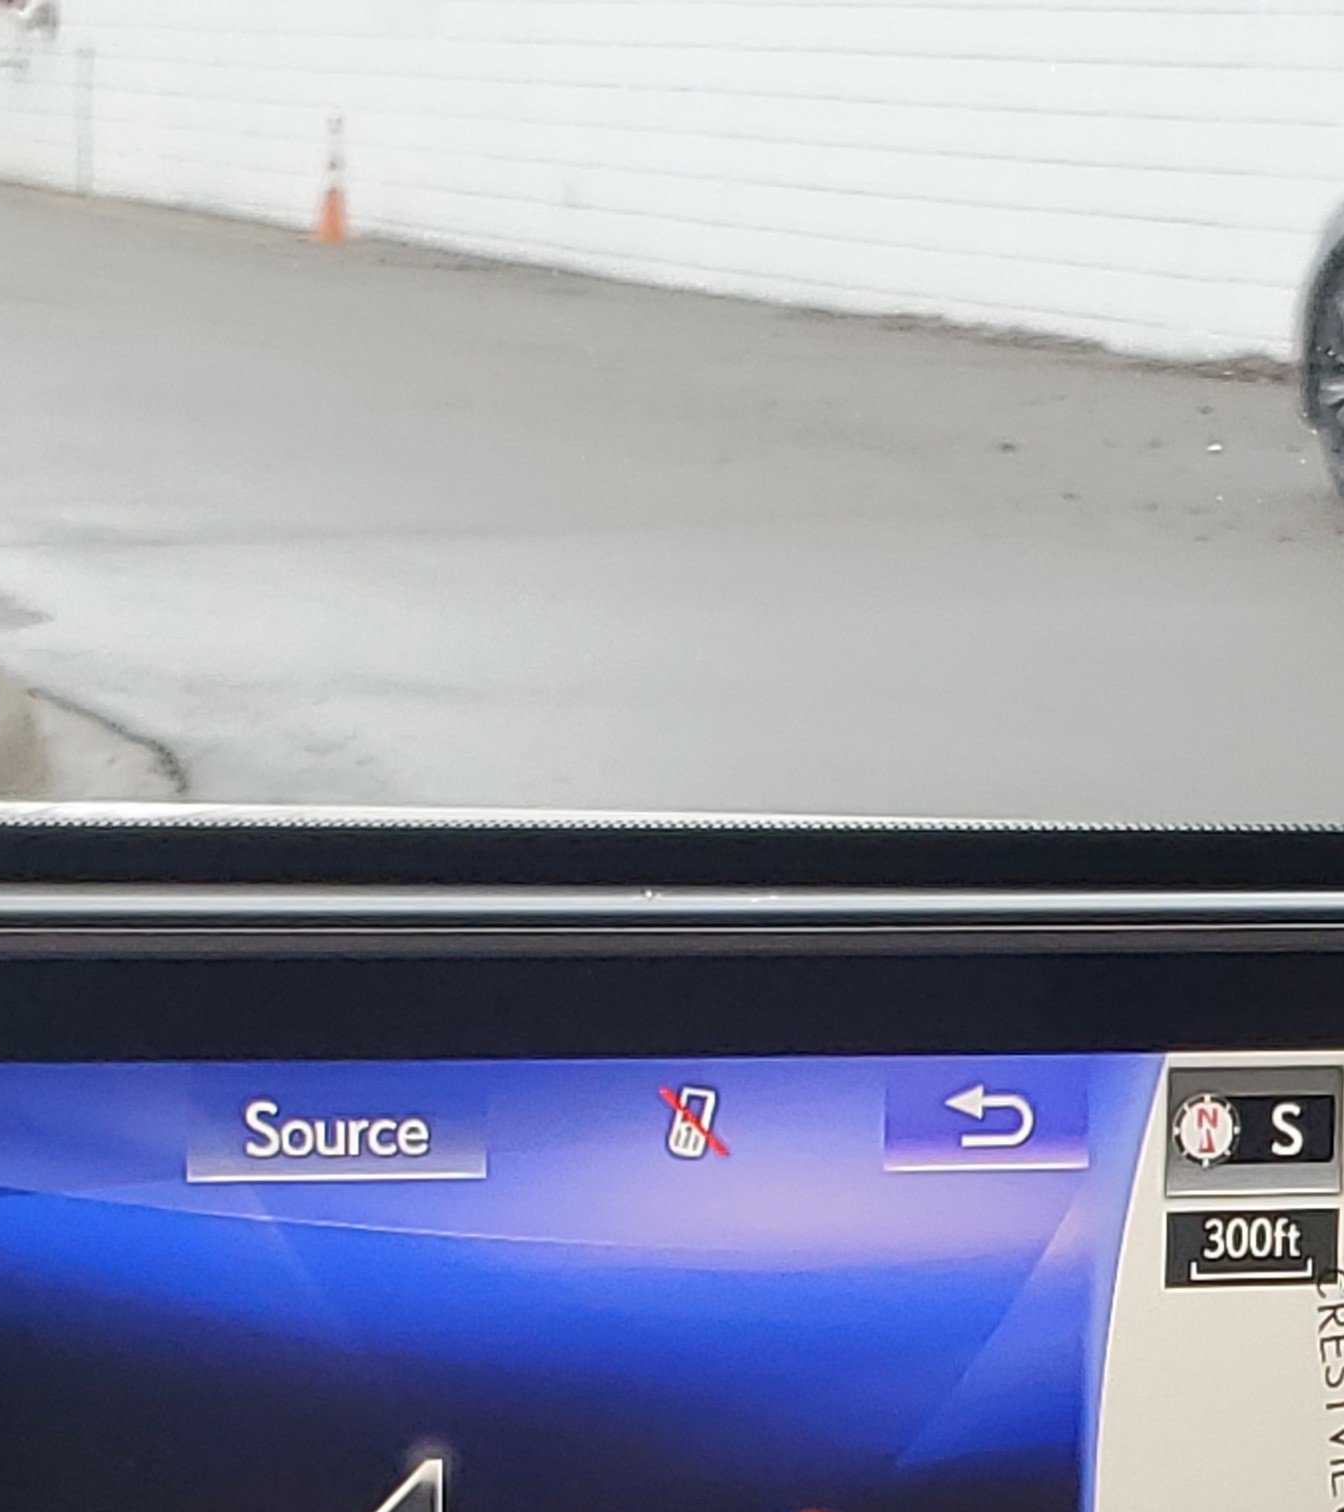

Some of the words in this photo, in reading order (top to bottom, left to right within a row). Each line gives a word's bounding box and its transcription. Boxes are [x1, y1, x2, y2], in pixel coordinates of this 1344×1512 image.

[244, 1102, 430, 1158] Source
[1196, 1107, 1218, 1129] N
[1270, 1103, 1304, 1156] S
[1203, 1217, 1301, 1260] 300ft
